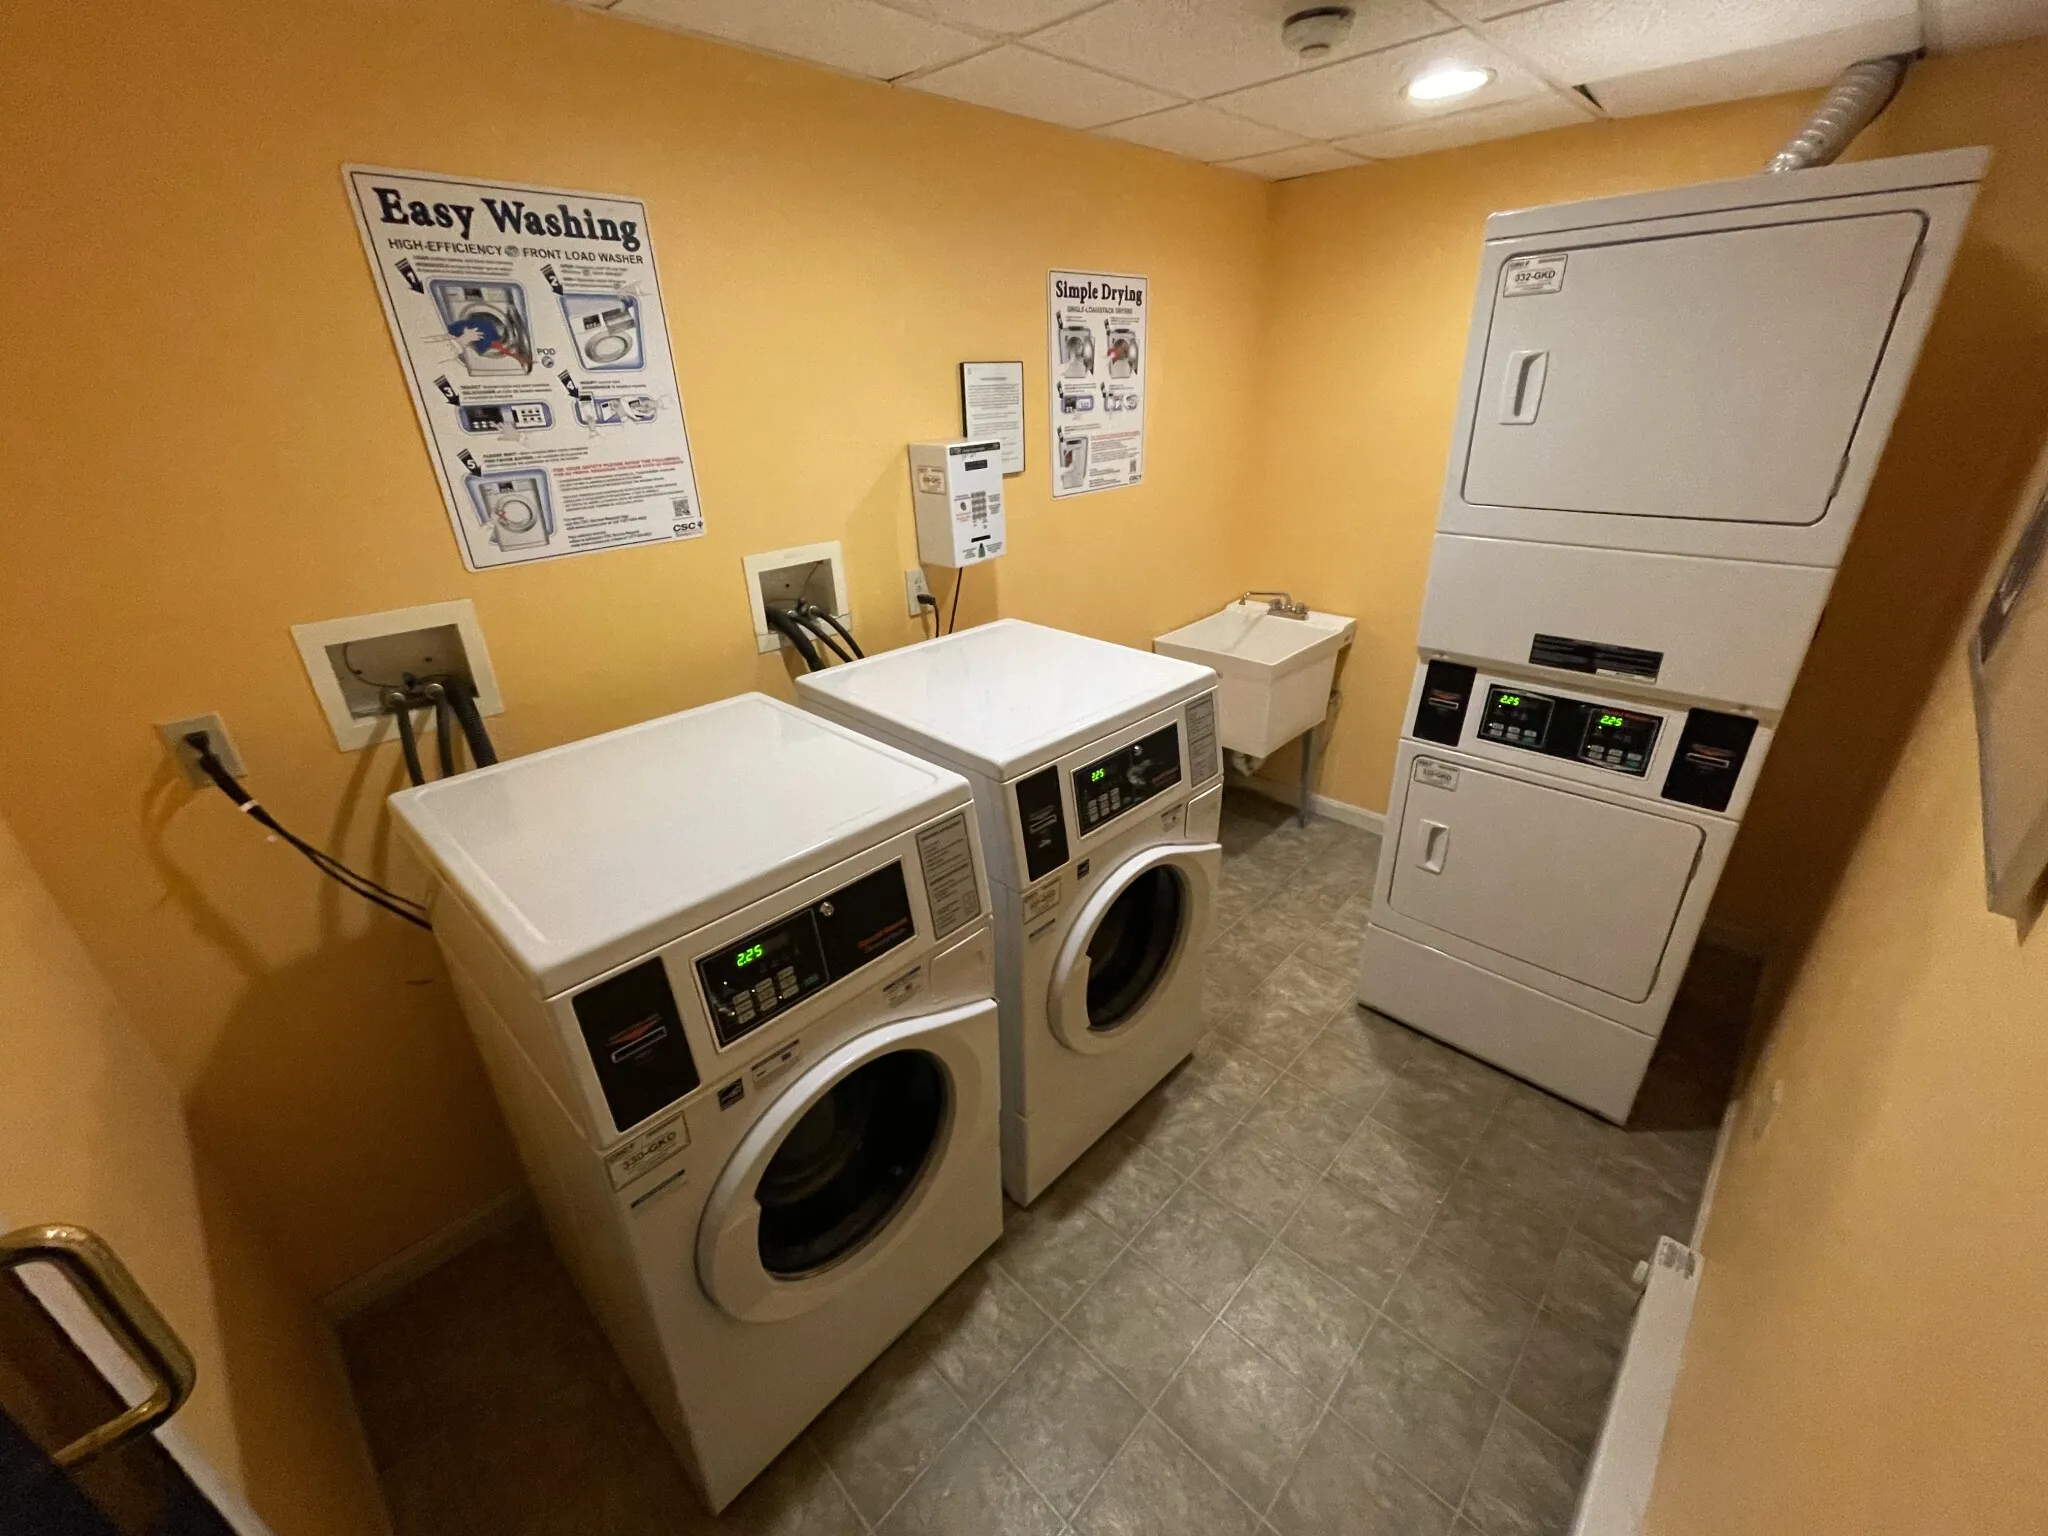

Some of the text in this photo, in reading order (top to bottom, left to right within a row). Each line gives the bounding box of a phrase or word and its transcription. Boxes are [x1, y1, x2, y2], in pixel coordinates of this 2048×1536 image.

[372, 187, 641, 252] Easy Washing
[388, 238, 644, 265] HIGH-EFFICIENCY FRONT LOAD WASHER
[407, 272, 416, 284] 1
[548, 276, 558, 286] 2
[1514, 270, 1556, 282] 332-GKD
[1055, 280, 1143, 306] Simple Drying
[537, 347, 556, 355] POD
[442, 386, 452, 397] 3
[466, 459, 476, 469] 5
[673, 521, 696, 533] CSC
[736, 944, 764, 967] 2.25
